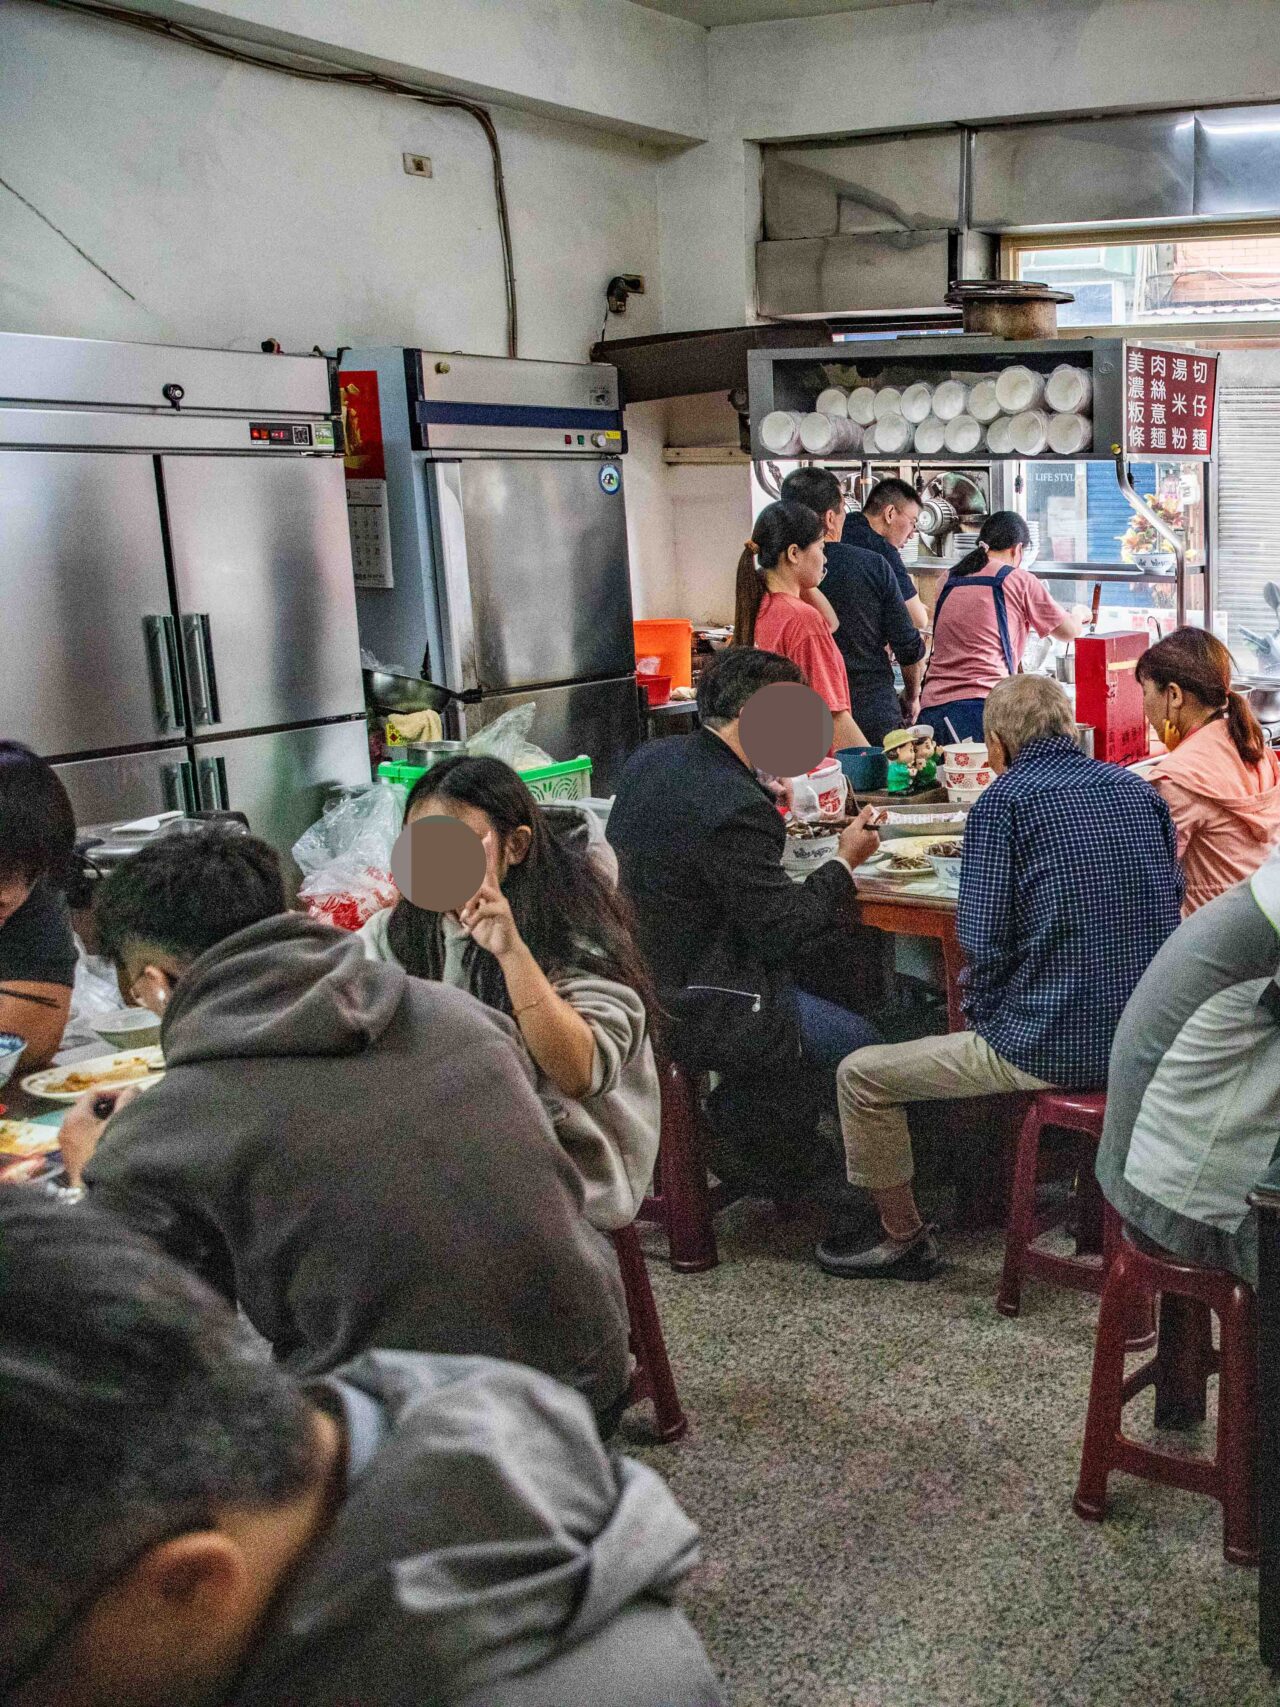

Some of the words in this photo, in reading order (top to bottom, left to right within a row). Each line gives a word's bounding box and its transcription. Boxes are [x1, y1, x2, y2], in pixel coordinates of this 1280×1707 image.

[1128, 351, 1145, 448] 美濃粄條
[1150, 355, 1167, 449] 肉絲意麵
[1172, 358, 1188, 449] 湯米粉
[1192, 361, 1208, 451] 切仔麵
[1035, 473, 1053, 482] LIFE
